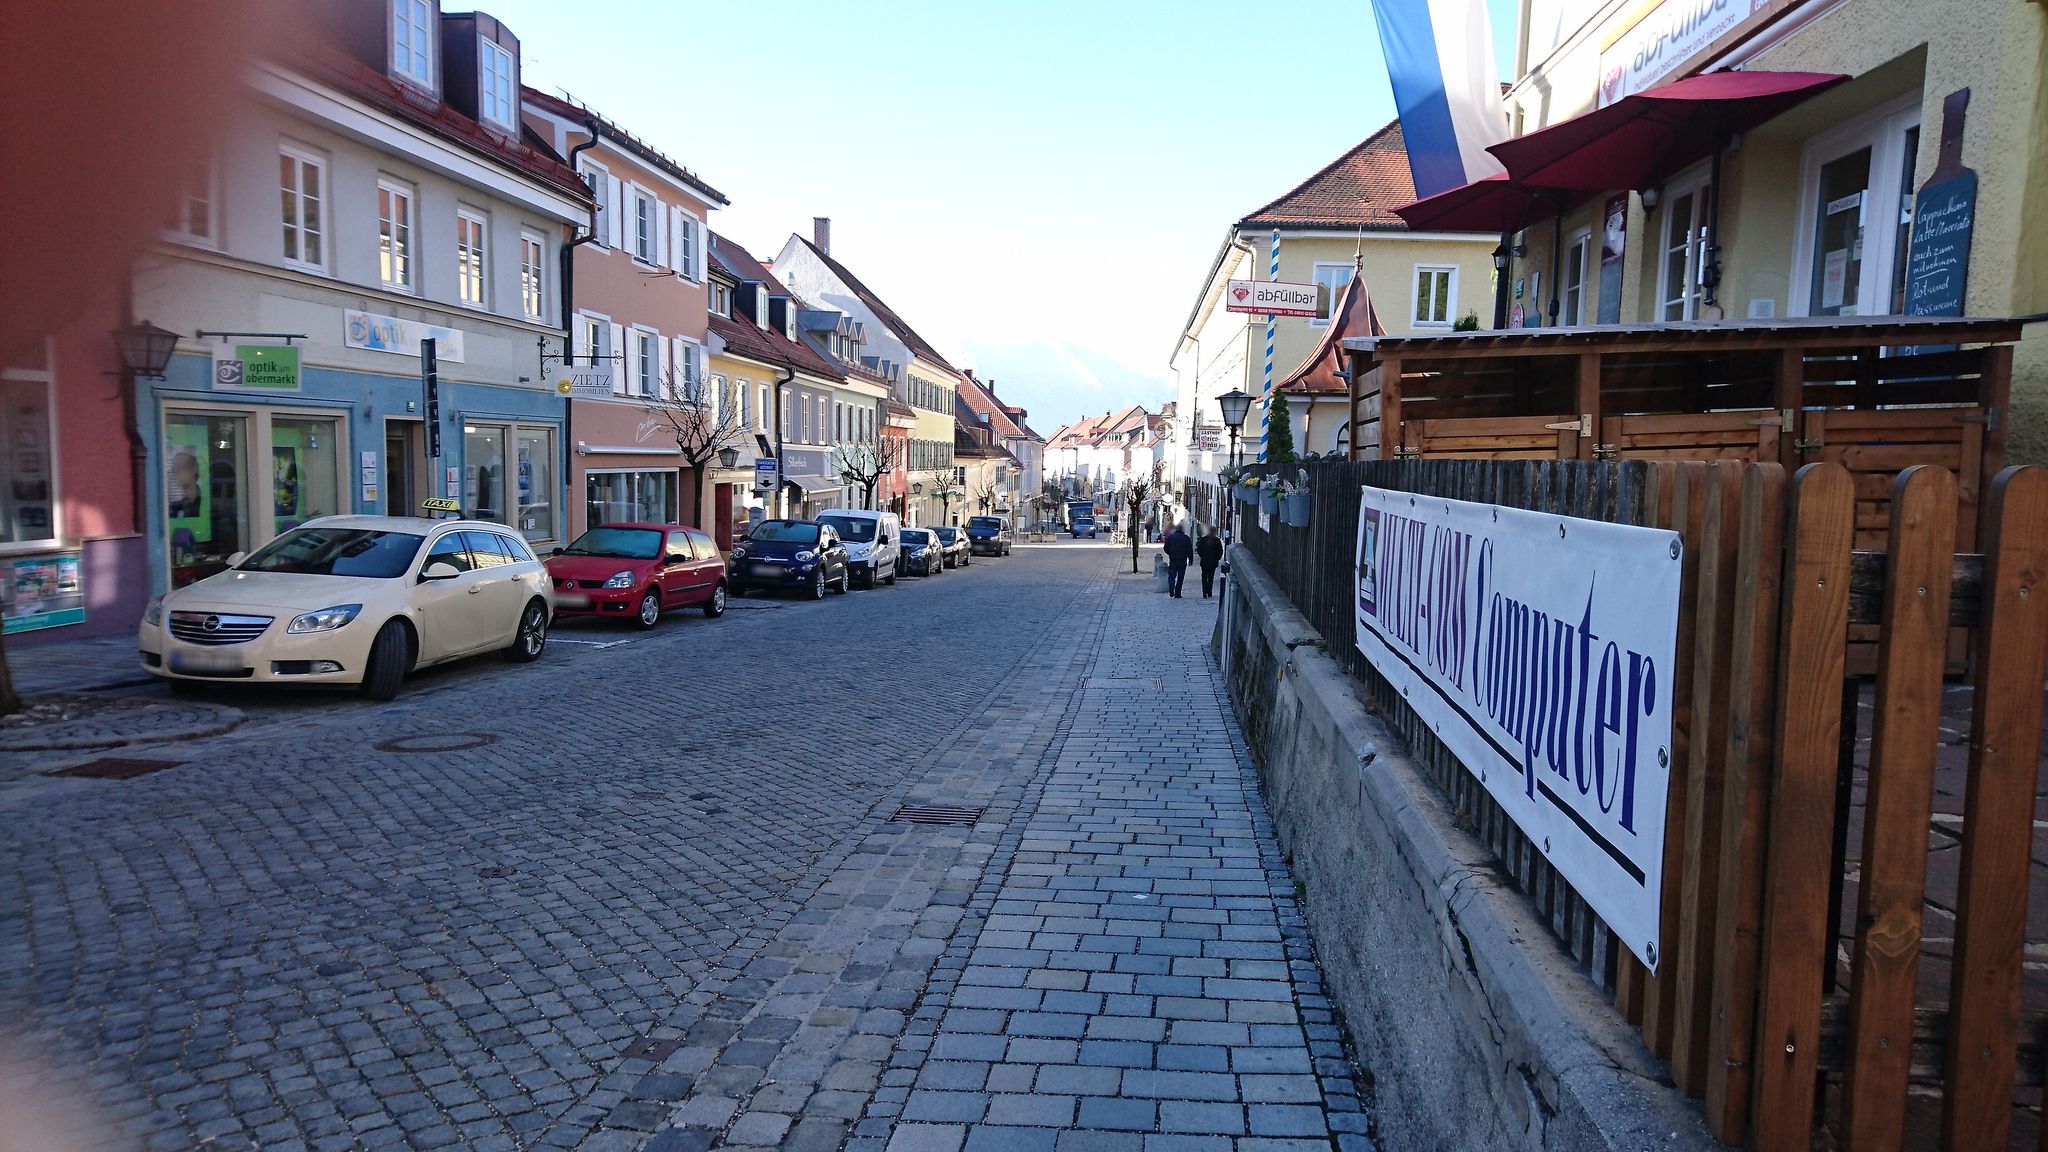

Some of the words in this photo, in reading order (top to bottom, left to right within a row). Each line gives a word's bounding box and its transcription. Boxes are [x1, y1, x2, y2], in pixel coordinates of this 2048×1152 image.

[1913, 245, 1932, 261] auch
[1934, 244, 1954, 256] zum
[1257, 288, 1315, 304] abfüllbar
[372, 322, 406, 345] optik
[249, 361, 277, 374] optik
[245, 371, 296, 385] obermarkt
[571, 374, 610, 386] ZIETZ
[571, 387, 611, 395] IMMOBILIEN
[427, 499, 452, 508] TAXI
[1378, 511, 1473, 693] MULTI-COM
[1473, 537, 1656, 837] Computer
